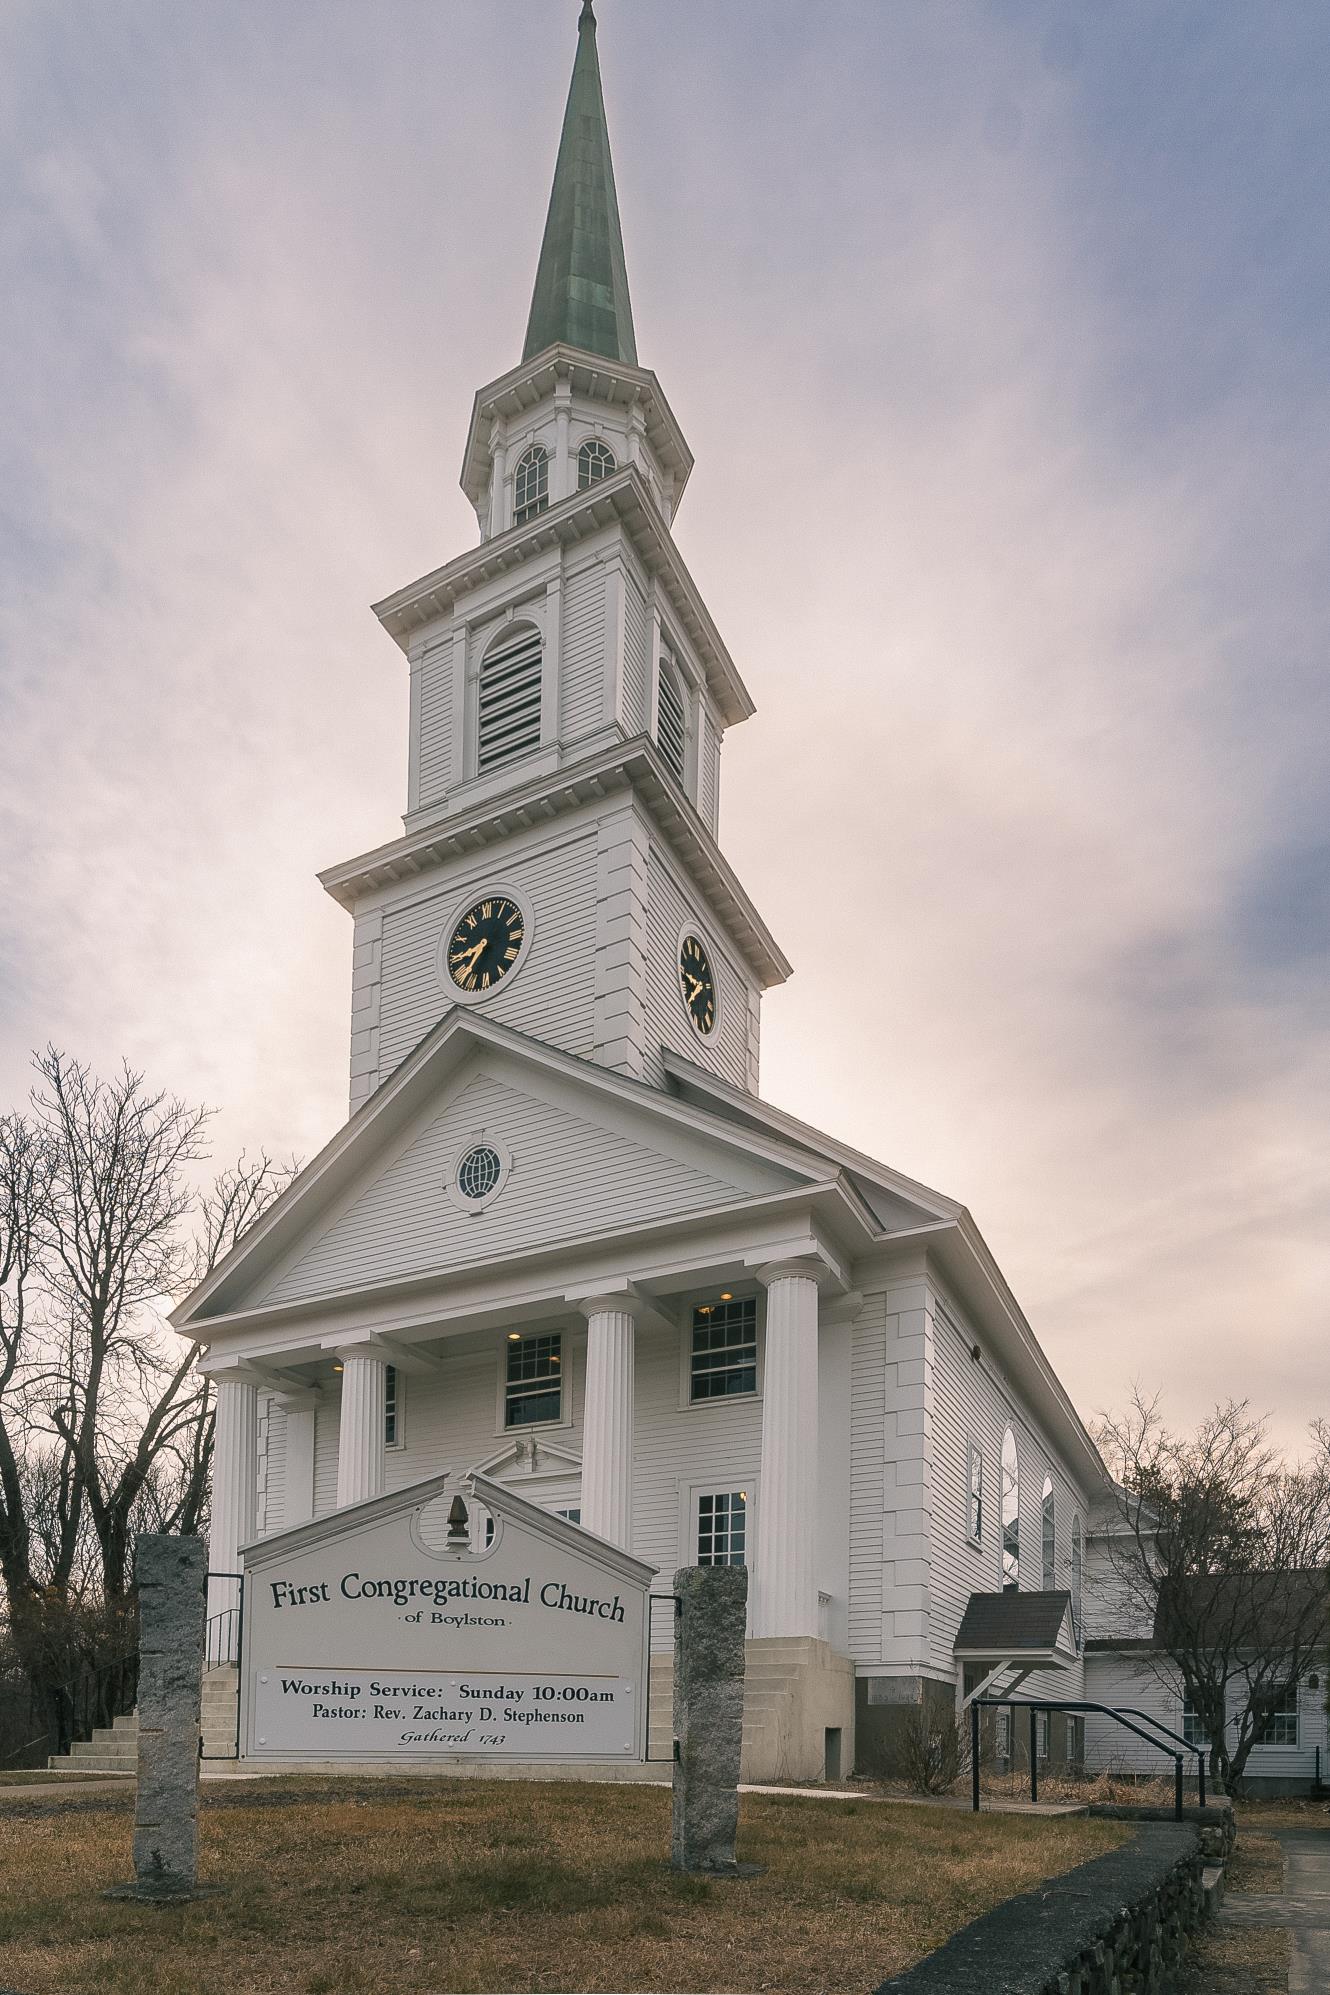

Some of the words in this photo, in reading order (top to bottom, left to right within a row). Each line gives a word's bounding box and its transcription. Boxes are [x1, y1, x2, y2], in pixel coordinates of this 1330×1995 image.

[270, 1581, 330, 1608] First
[340, 1573, 530, 1606] Congregational
[540, 1582, 625, 1623] Church
[280, 1679, 361, 1699] Worship
[369, 1682, 443, 1698] Service:
[459, 1684, 525, 1702] Sunday
[532, 1686, 615, 1702] 10:00am
[312, 1703, 367, 1719] Pastor:
[373, 1704, 406, 1720] Rev.
[412, 1705, 473, 1724] Zachary
[479, 1707, 497, 1722] D.
[503, 1707, 585, 1726] Stephenson
[398, 1728, 476, 1746] Gathered
[479, 1735, 506, 1746] 1743
